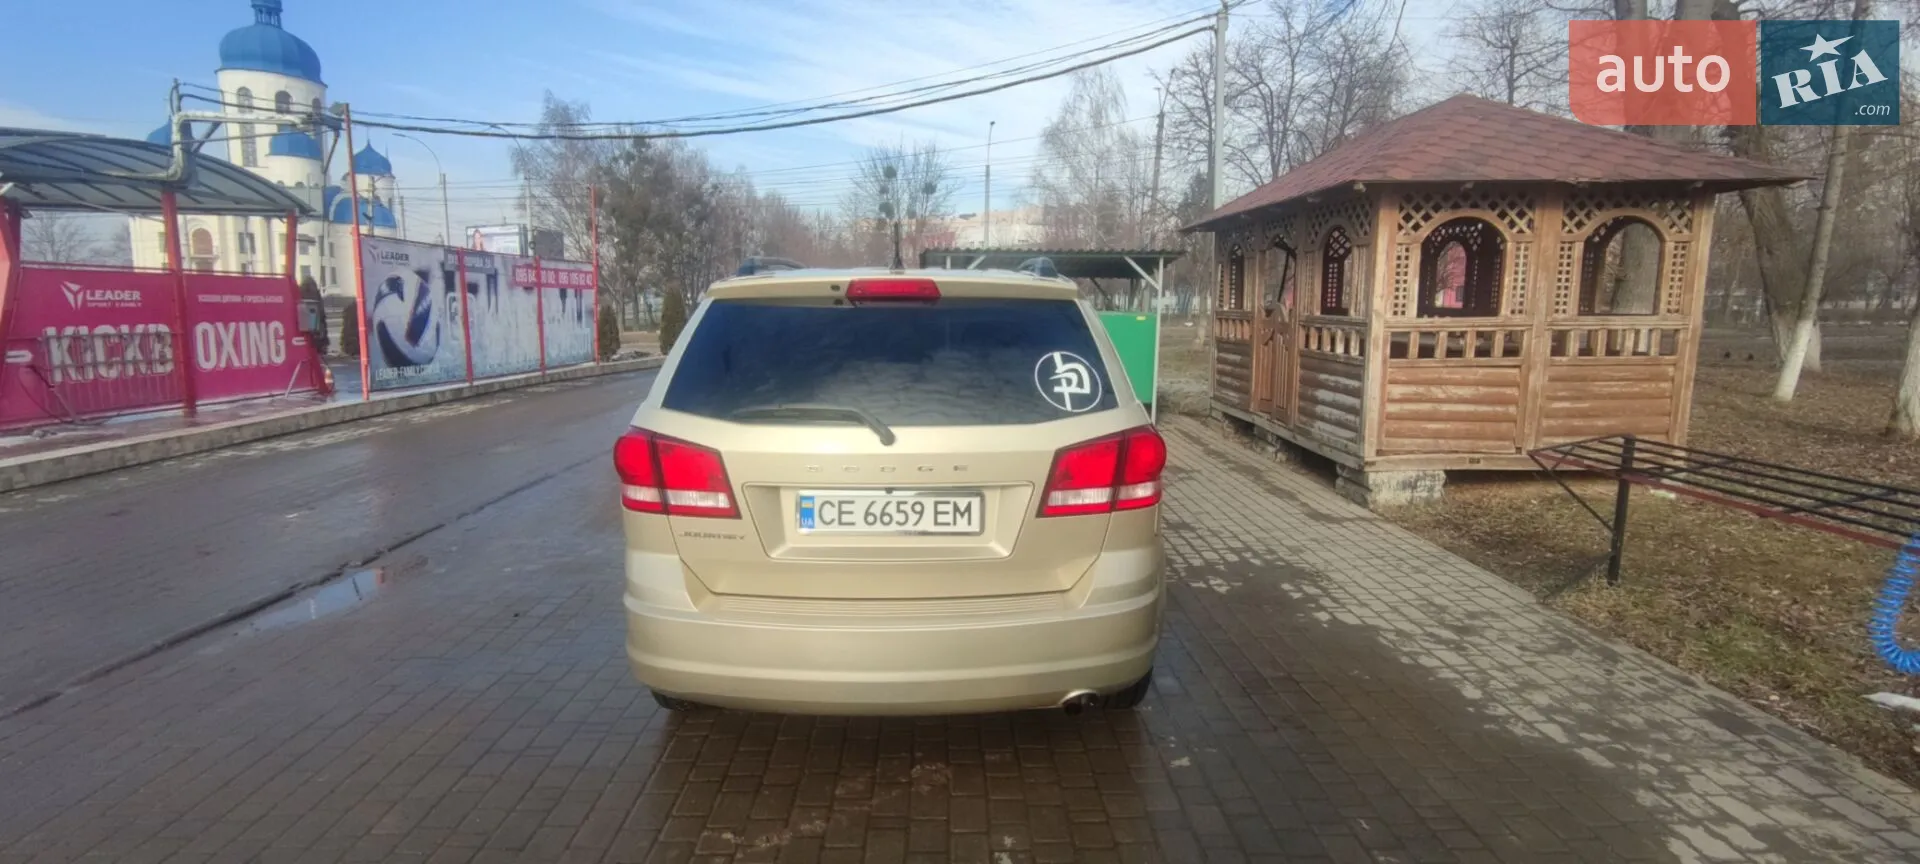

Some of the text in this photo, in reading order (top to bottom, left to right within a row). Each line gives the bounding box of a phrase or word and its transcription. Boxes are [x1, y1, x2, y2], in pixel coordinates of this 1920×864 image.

[381, 250, 409, 261] LEADER
[86, 290, 141, 300] LEADER
[819, 500, 972, 527] CE 6659 EM
[801, 517, 813, 526] UA
